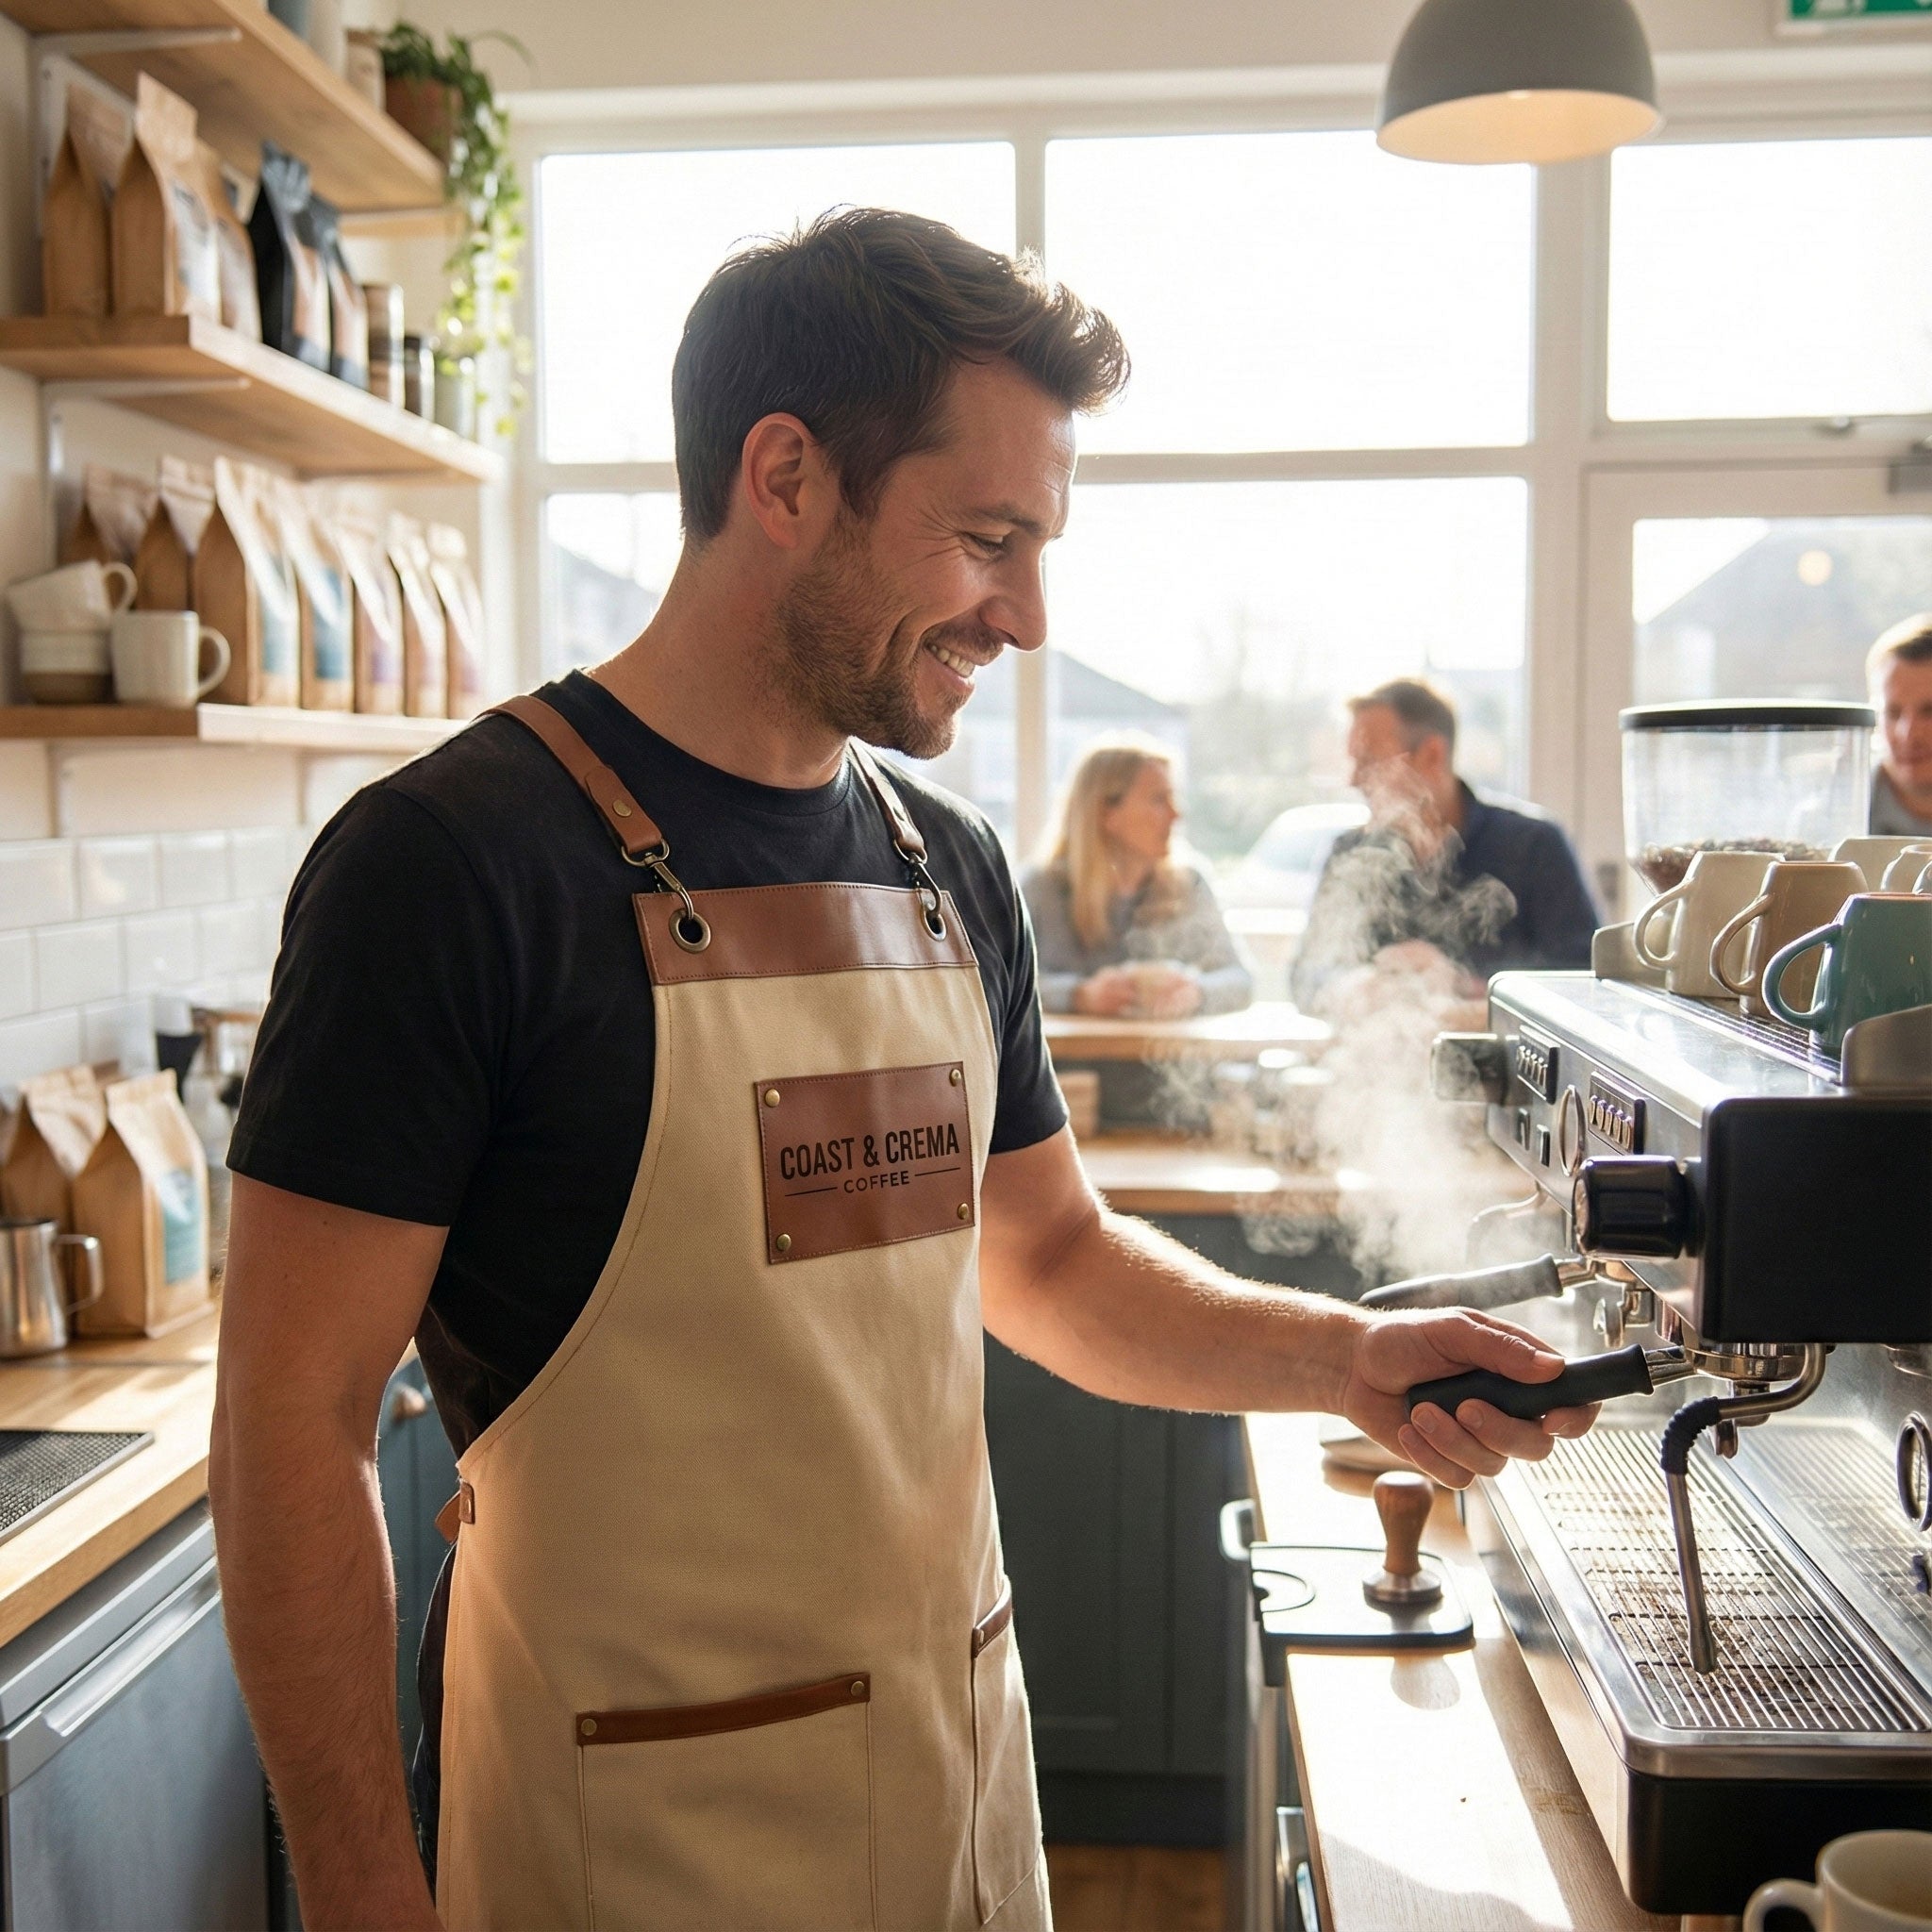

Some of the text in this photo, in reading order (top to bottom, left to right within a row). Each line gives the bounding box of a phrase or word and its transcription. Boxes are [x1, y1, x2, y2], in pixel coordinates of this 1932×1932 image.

[780, 1124, 960, 1180] COAST & CREMA
[843, 1171, 910, 1193] COFFEE
